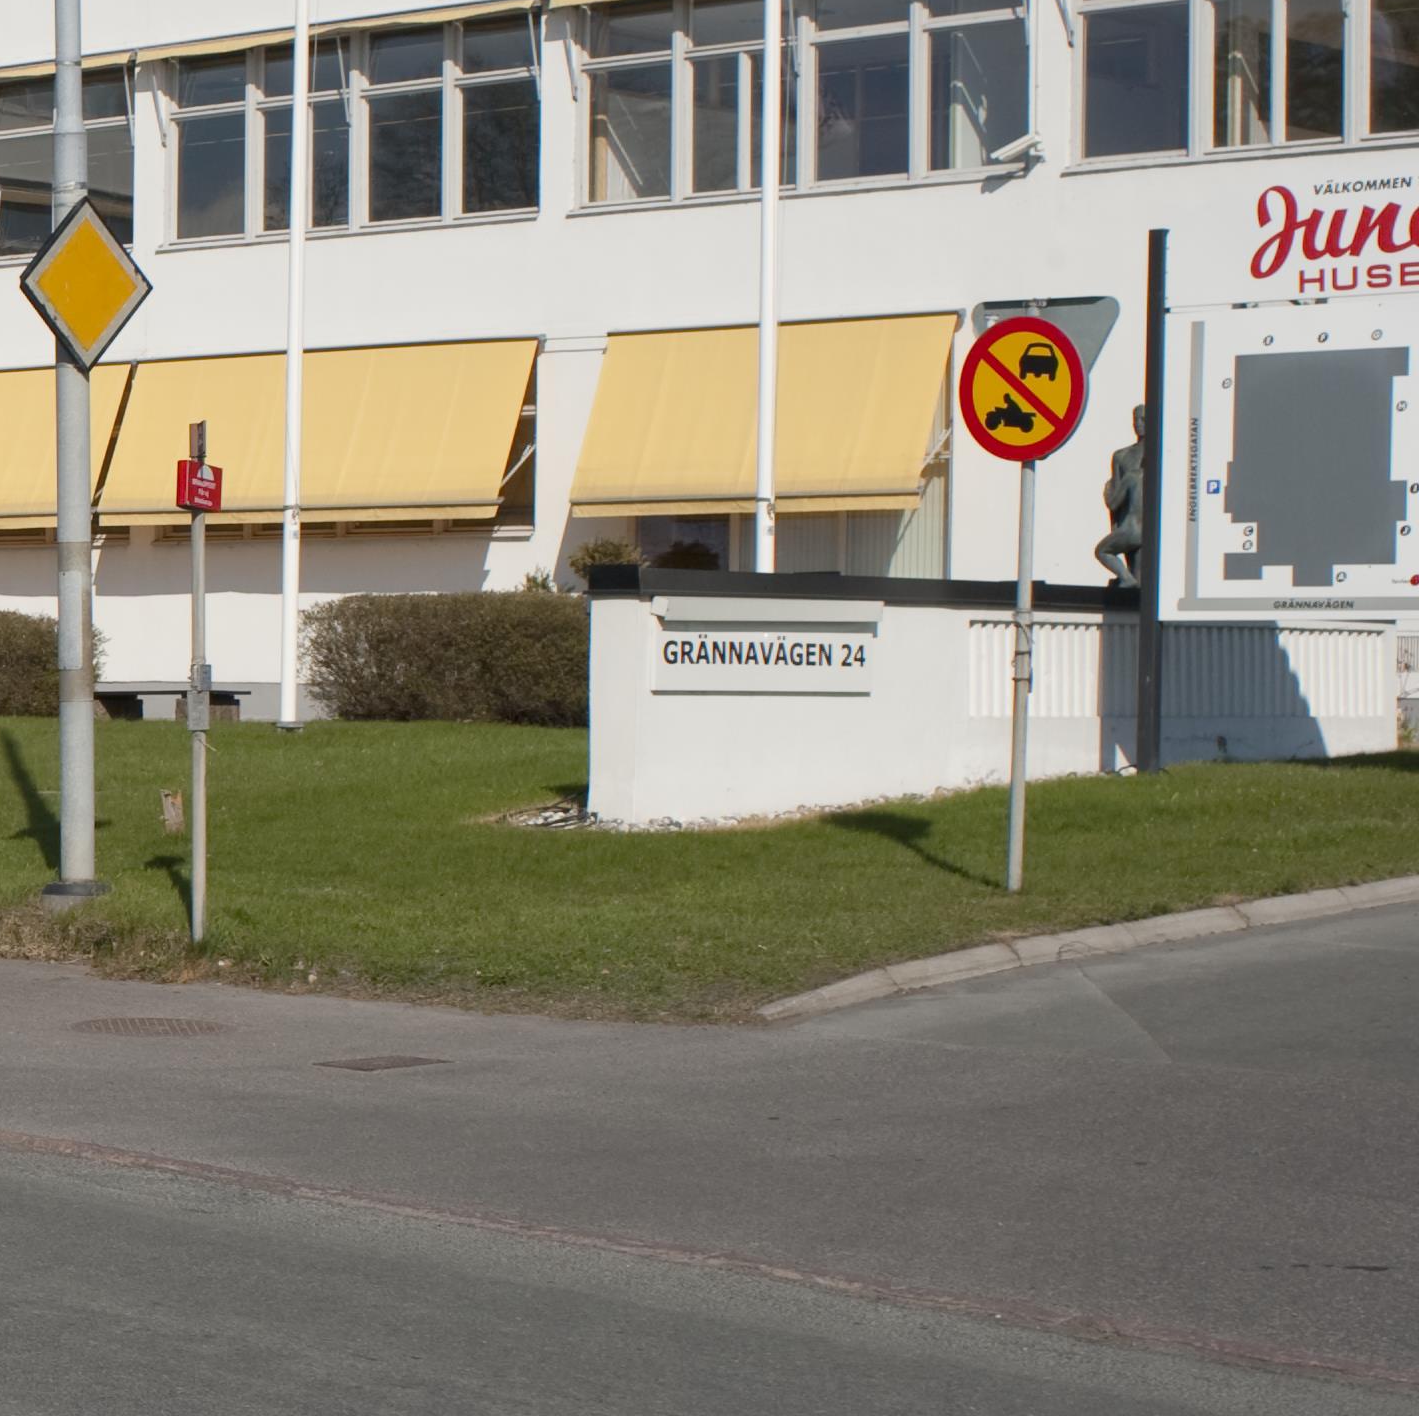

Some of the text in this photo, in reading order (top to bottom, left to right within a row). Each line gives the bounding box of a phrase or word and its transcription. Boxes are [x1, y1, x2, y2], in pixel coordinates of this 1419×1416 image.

[1313, 176, 1412, 195] VÄLKOMMEN
[1189, 417, 1198, 522] ENGELBREKTSGATAN
[1273, 598, 1354, 609] GRÄNNAVÄGEN
[663, 634, 866, 667] GRÄNNAVÄGEN 24
